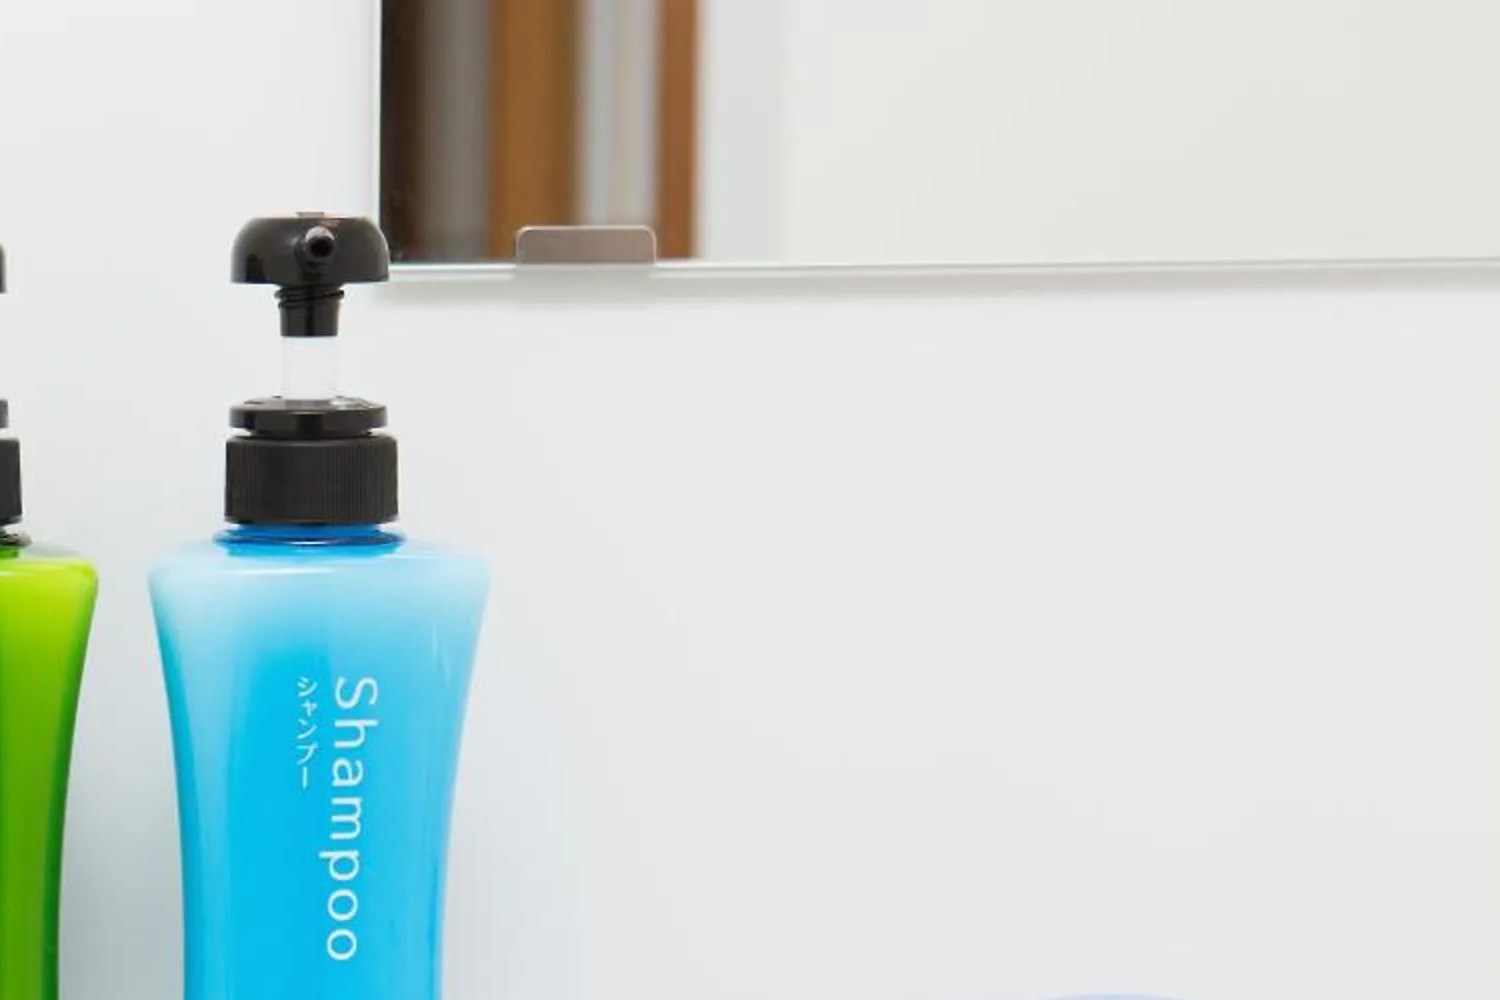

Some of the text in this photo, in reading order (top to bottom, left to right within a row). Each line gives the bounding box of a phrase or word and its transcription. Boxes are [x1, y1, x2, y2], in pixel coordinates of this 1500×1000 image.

[296, 676, 318, 789] シャンプー
[318, 676, 379, 961] Shampoo
